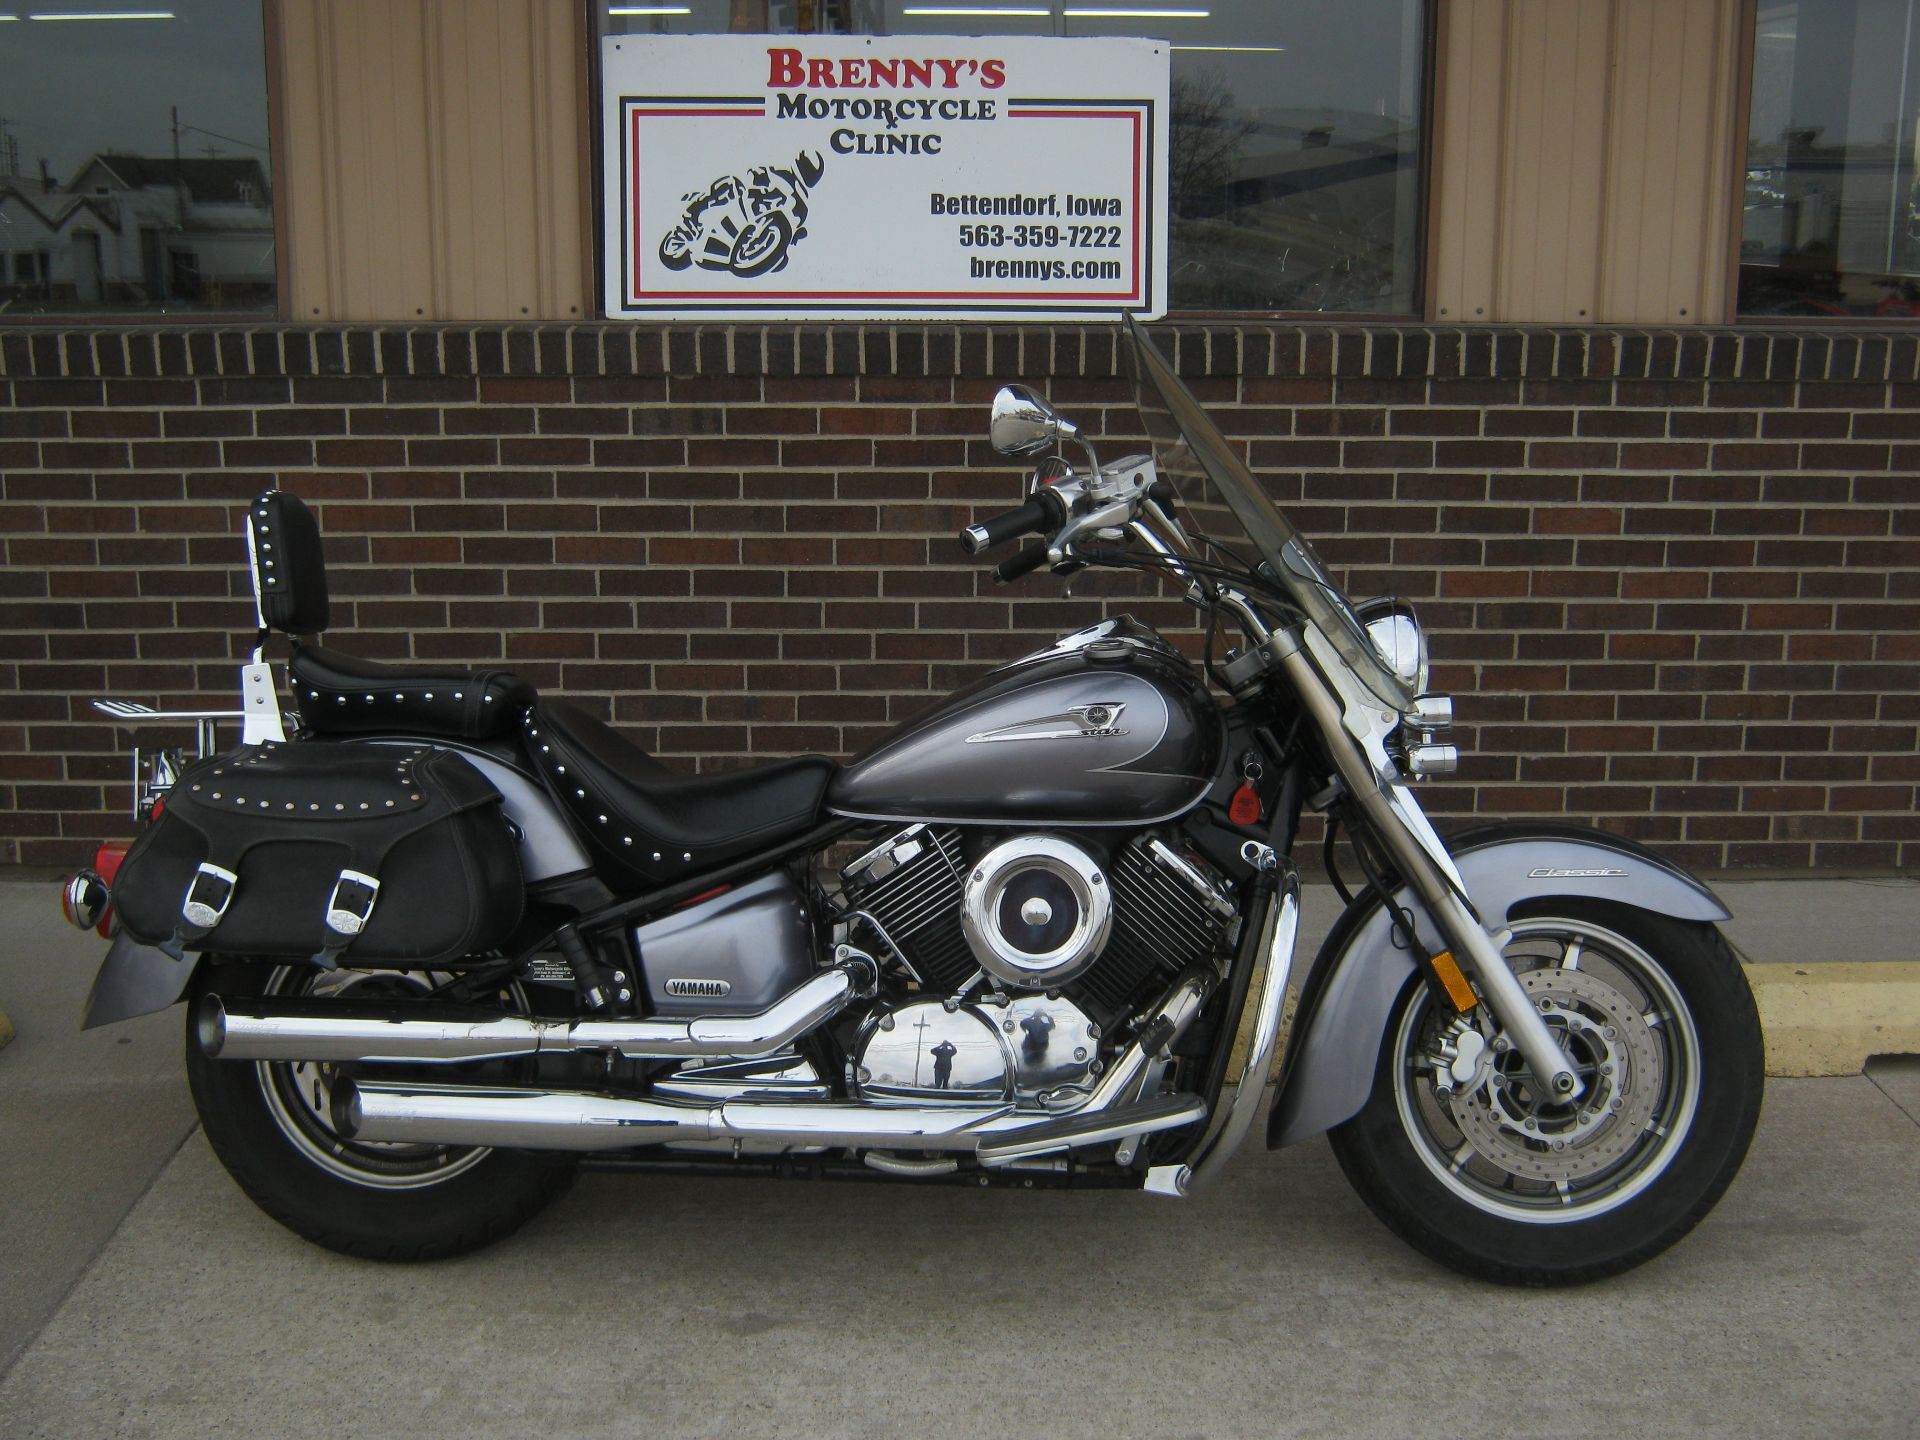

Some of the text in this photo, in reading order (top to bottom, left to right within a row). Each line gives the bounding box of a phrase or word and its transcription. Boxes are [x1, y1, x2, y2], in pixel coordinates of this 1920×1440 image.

[767, 48, 1005, 89] BRENNY'S
[777, 93, 996, 129] MOTORCYCLE
[830, 129, 941, 154] CLINIC
[931, 194, 1121, 218] Bettendorf, Iowa
[960, 225, 1121, 247] 563-359-7222
[971, 257, 1121, 280] brennys.com
[1528, 867, 1629, 878] Classic
[672, 981, 723, 996] YAMAHA
